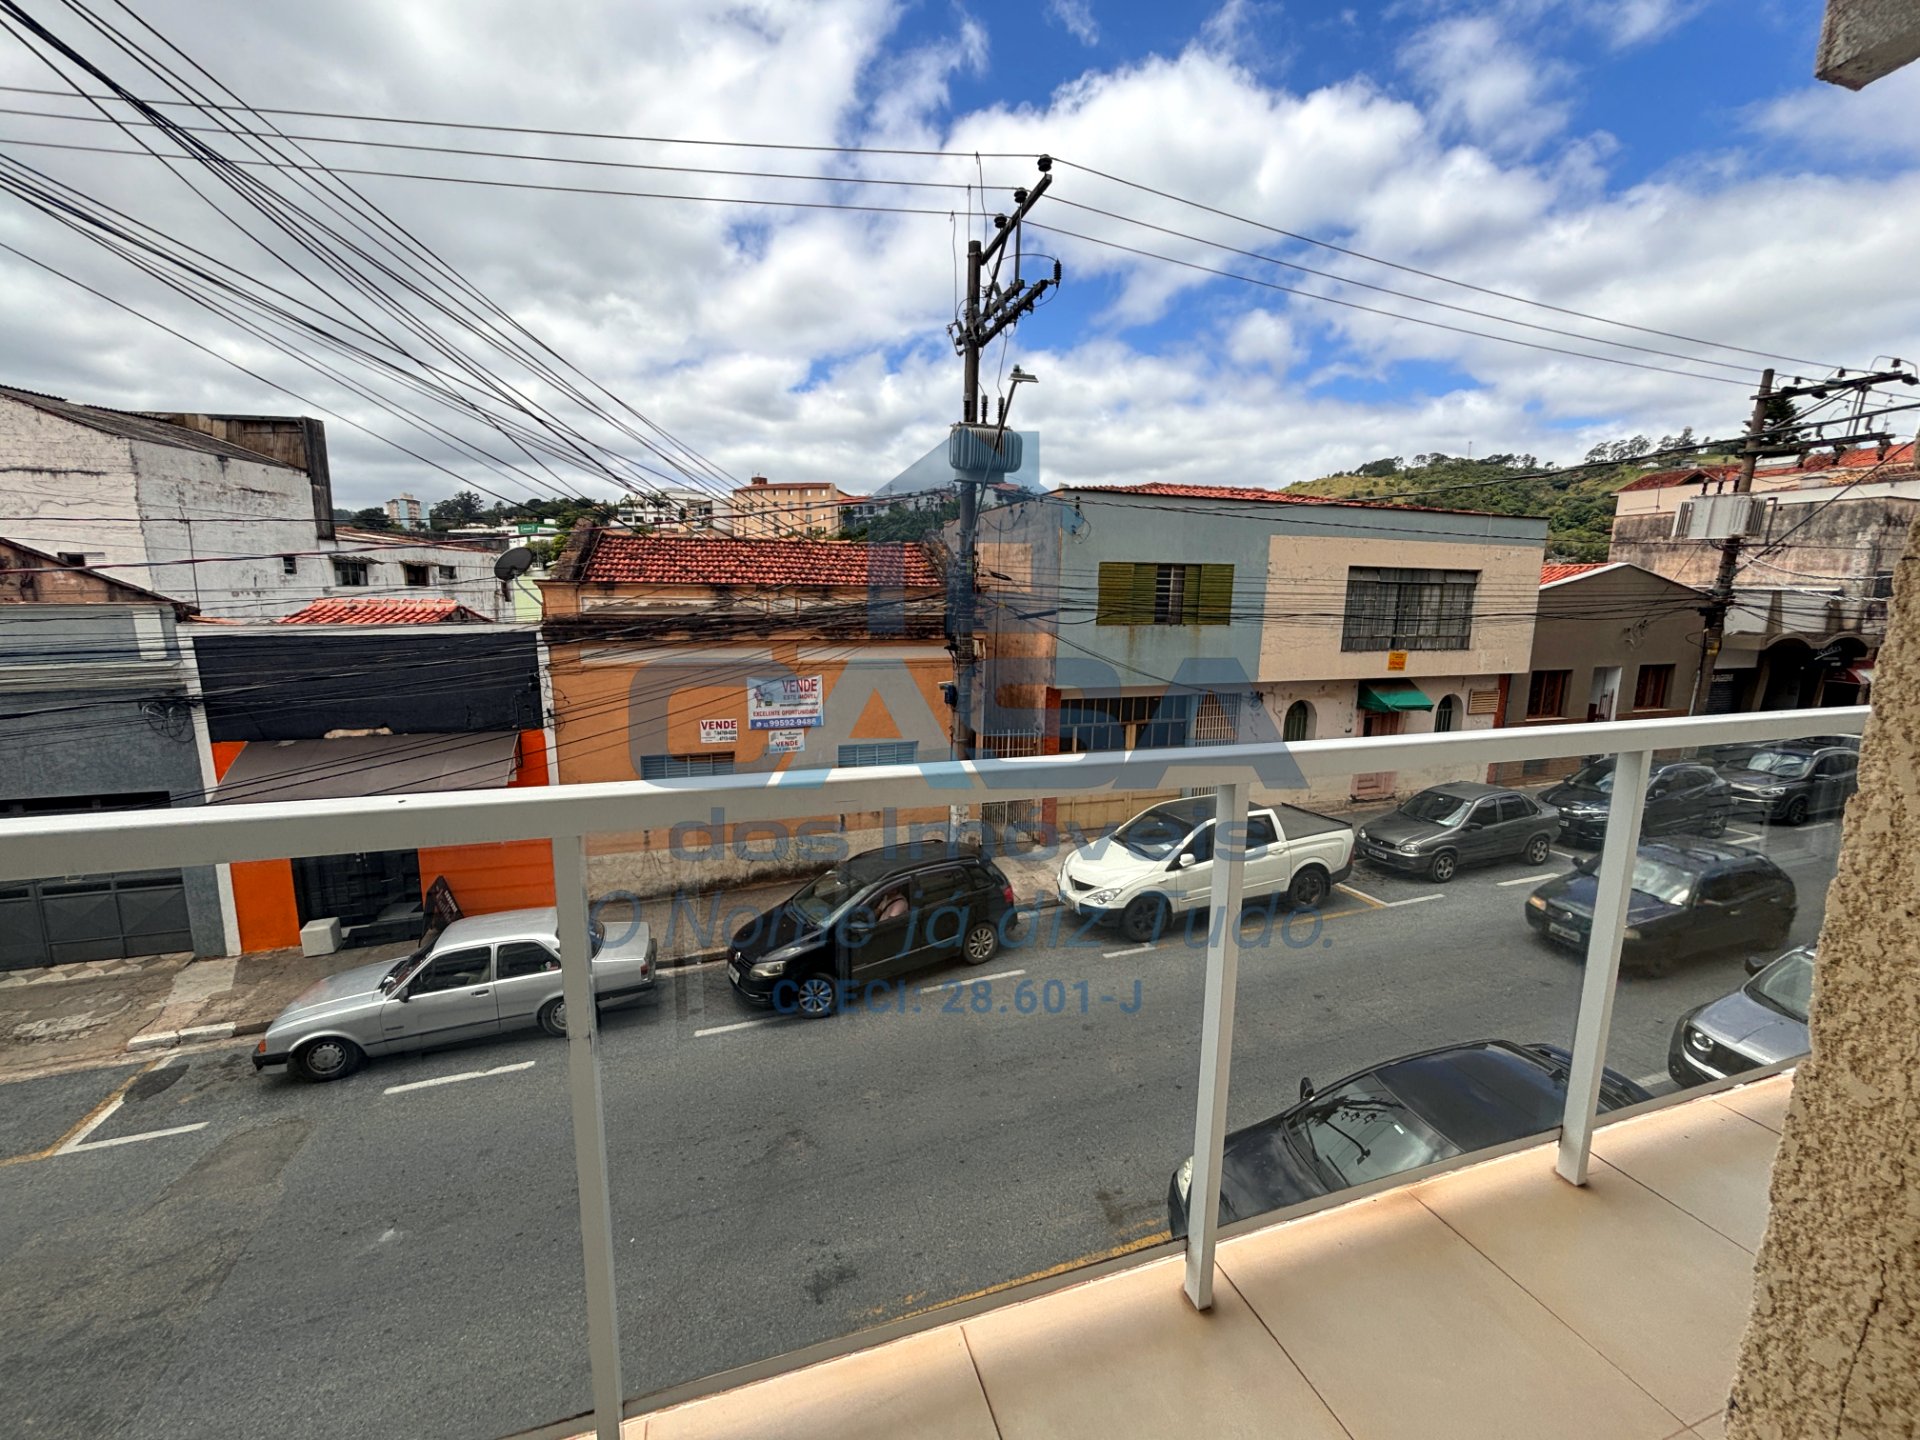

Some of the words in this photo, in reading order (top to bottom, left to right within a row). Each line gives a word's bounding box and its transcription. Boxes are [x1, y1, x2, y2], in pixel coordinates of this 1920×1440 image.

[782, 679, 818, 693] VENDE
[782, 708, 819, 716] OPORTUNIDADE
[701, 720, 737, 730] VENDE
